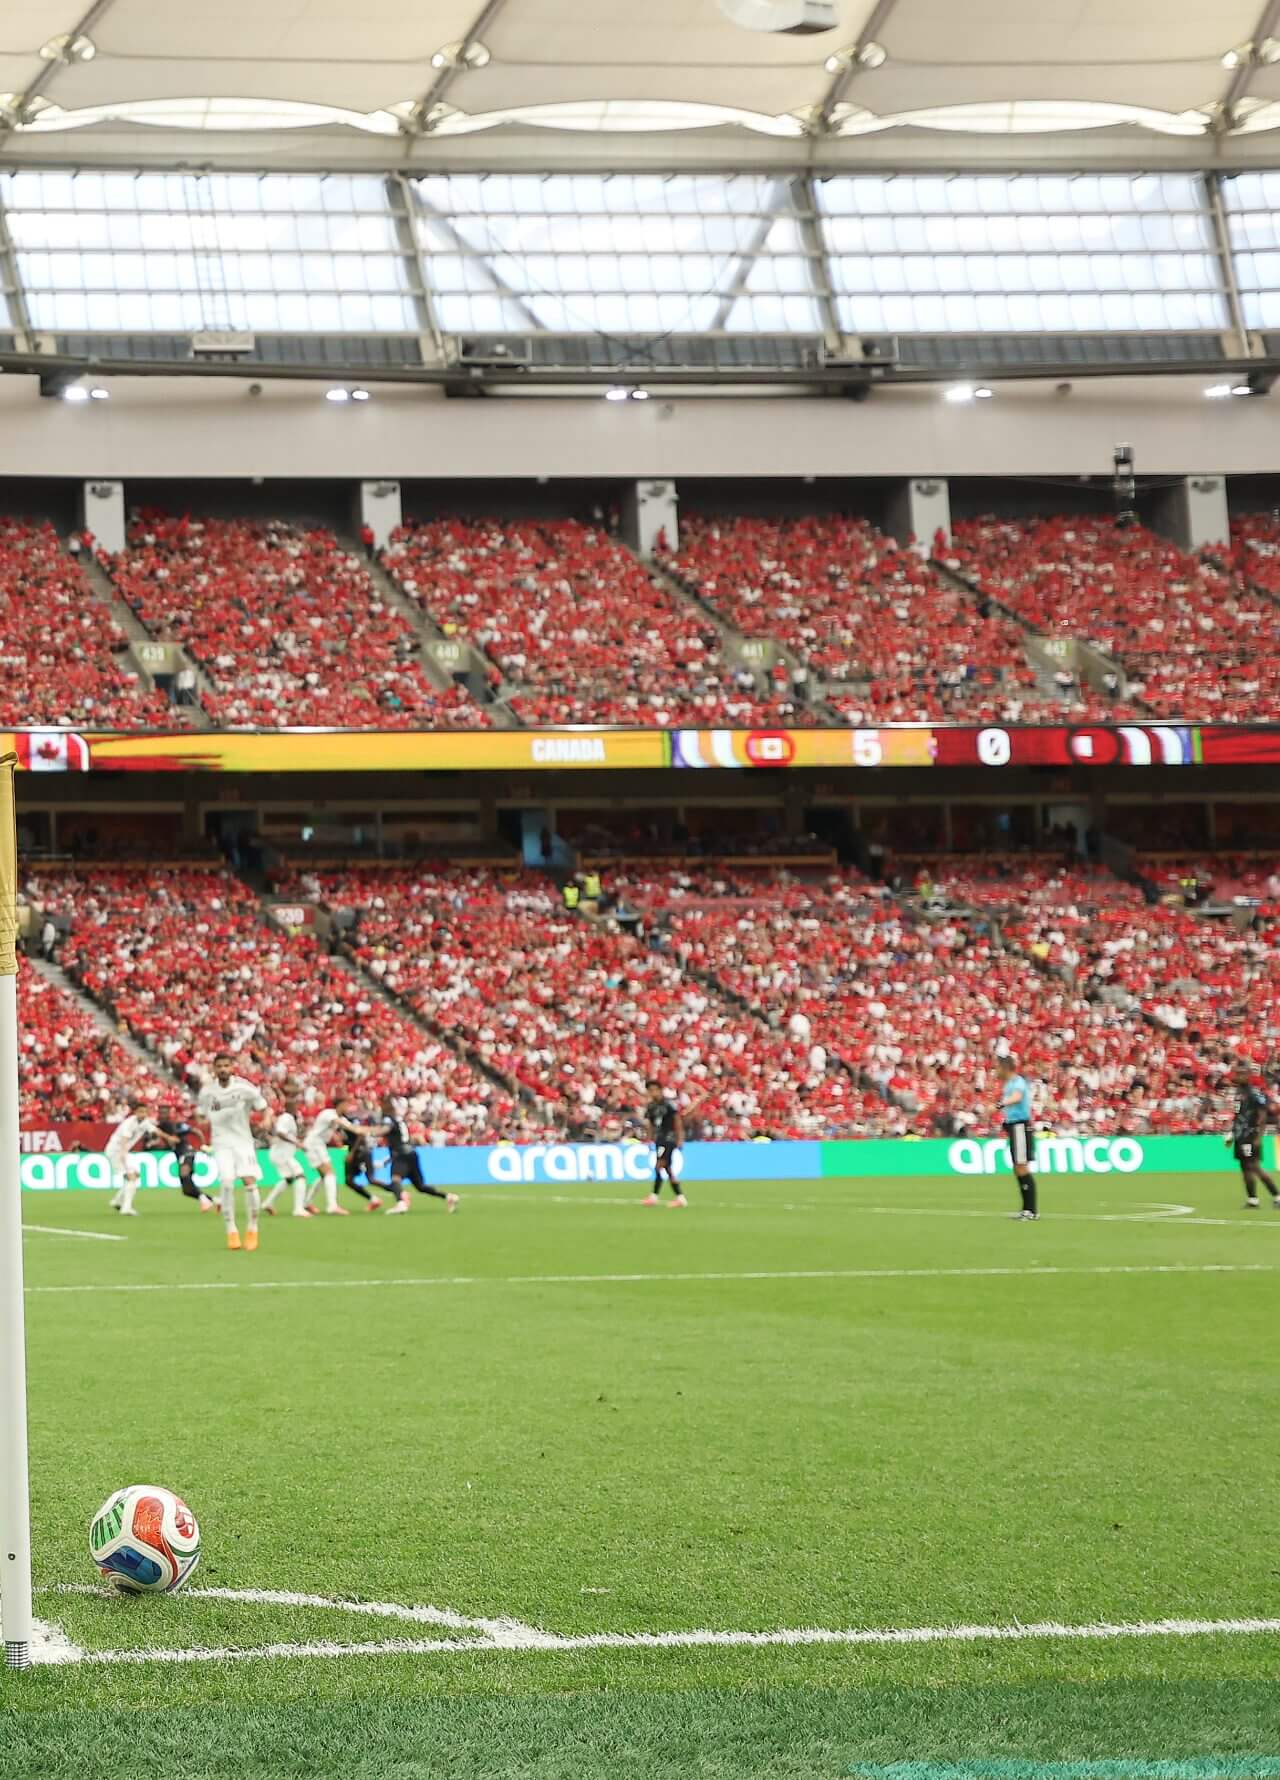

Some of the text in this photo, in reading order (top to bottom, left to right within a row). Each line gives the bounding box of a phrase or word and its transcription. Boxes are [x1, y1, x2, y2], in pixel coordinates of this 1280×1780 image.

[531, 737, 606, 761] CANADA
[852, 729, 883, 767] 5
[977, 728, 1012, 766] 0
[487, 1145, 684, 1182] aramco
